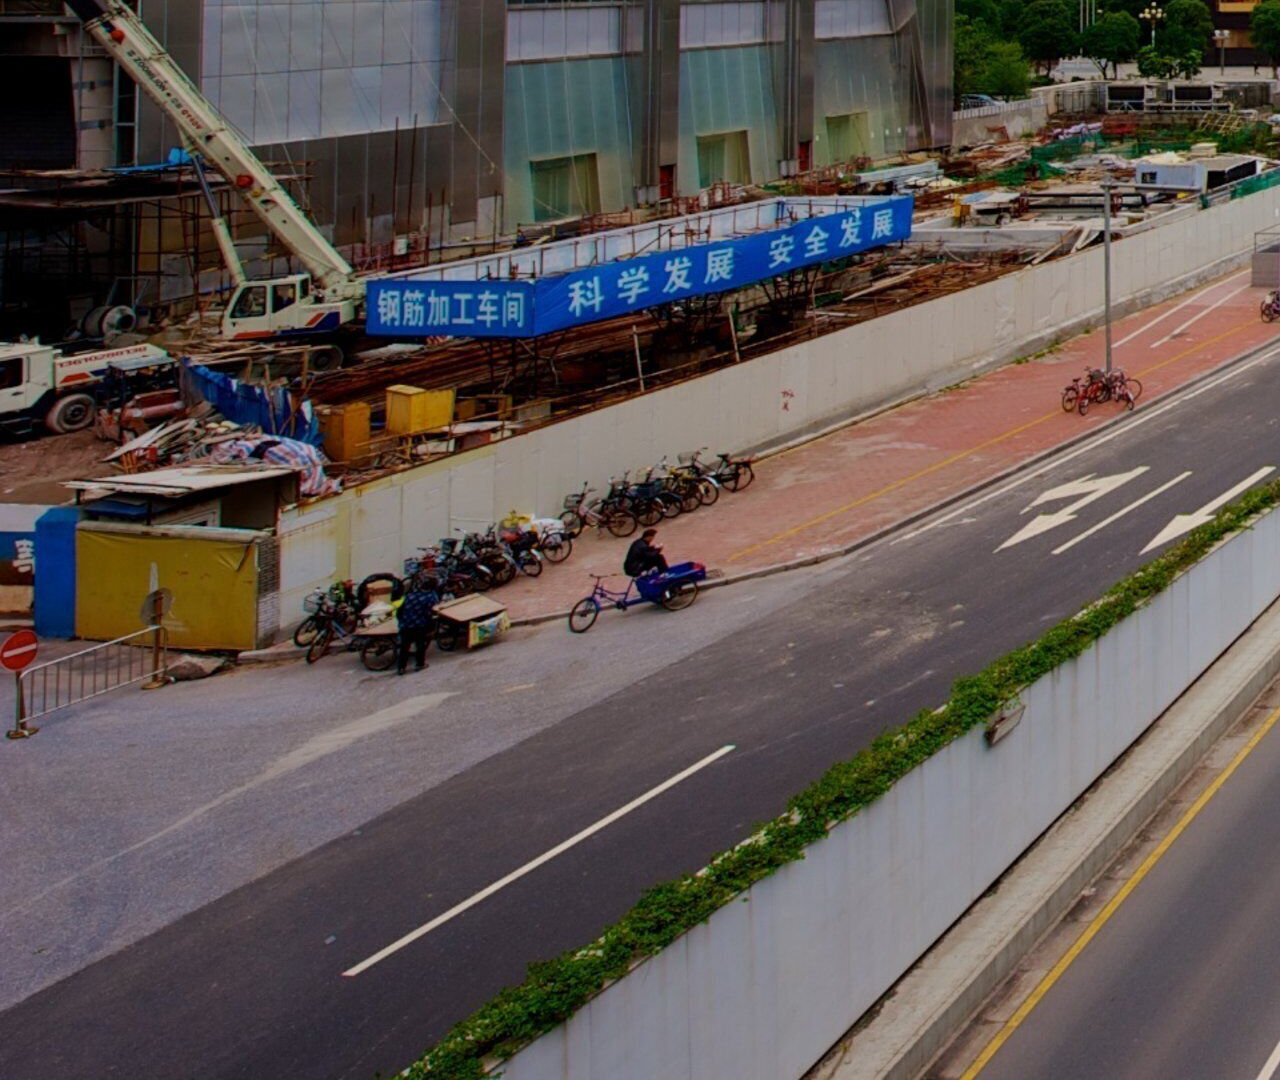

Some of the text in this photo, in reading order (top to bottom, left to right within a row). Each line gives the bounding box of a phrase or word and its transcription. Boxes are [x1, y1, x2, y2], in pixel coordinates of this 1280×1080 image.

[568, 208, 895, 318] 科学发展 安全发展
[377, 289, 525, 329] 钢筋加工车间
